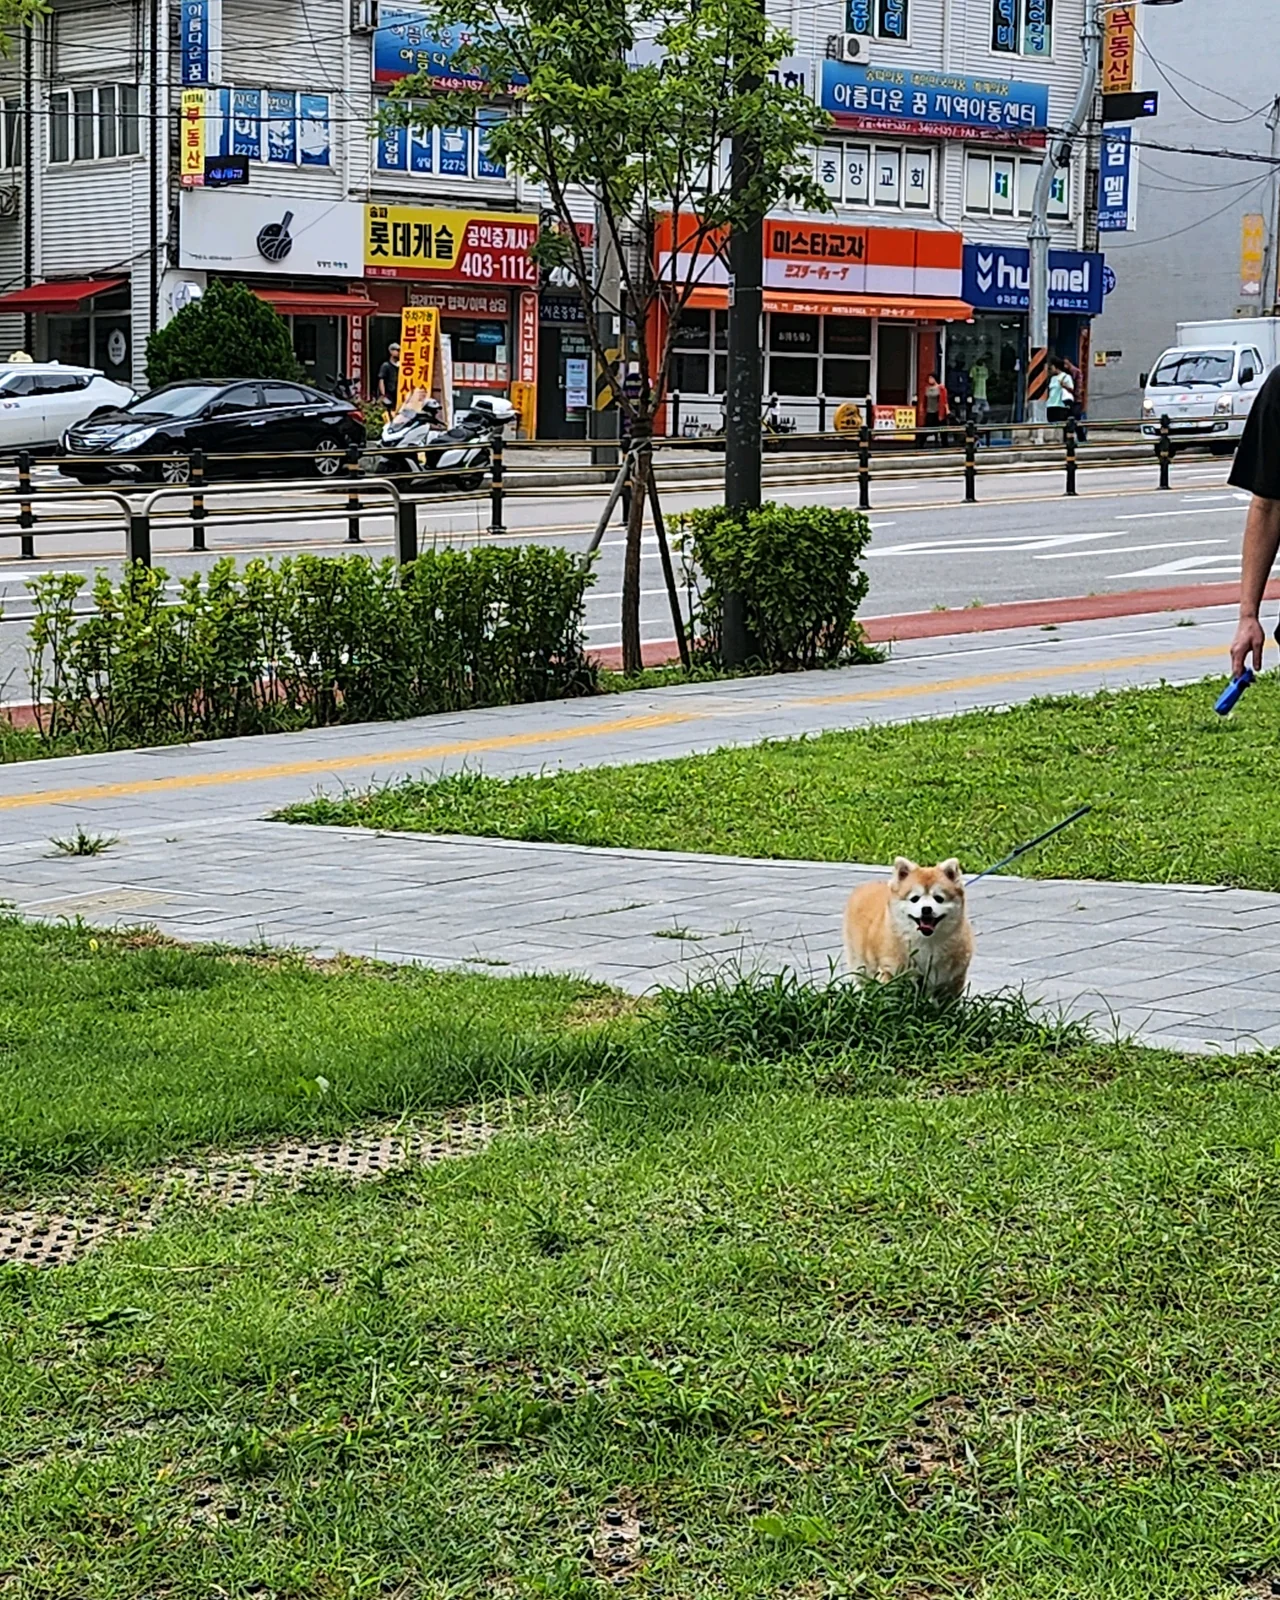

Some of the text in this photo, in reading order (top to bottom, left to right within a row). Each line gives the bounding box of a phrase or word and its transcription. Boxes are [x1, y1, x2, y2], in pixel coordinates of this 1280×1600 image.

[1107, 13, 1131, 82] 부동산
[833, 83, 1036, 127] 아름다운 꿈 지역아동센터
[186, 105, 201, 170] 부동산
[235, 143, 260, 157] 2275
[442, 158, 466, 172] 2275
[369, 206, 388, 219] 송파
[370, 221, 454, 260] 롯데캐슬
[467, 225, 528, 250] 공인중개사
[773, 230, 864, 259] 미스타교자
[460, 252, 536, 281] 403-1112
[997, 255, 1090, 293] humel
[489, 298, 507, 313] 상담
